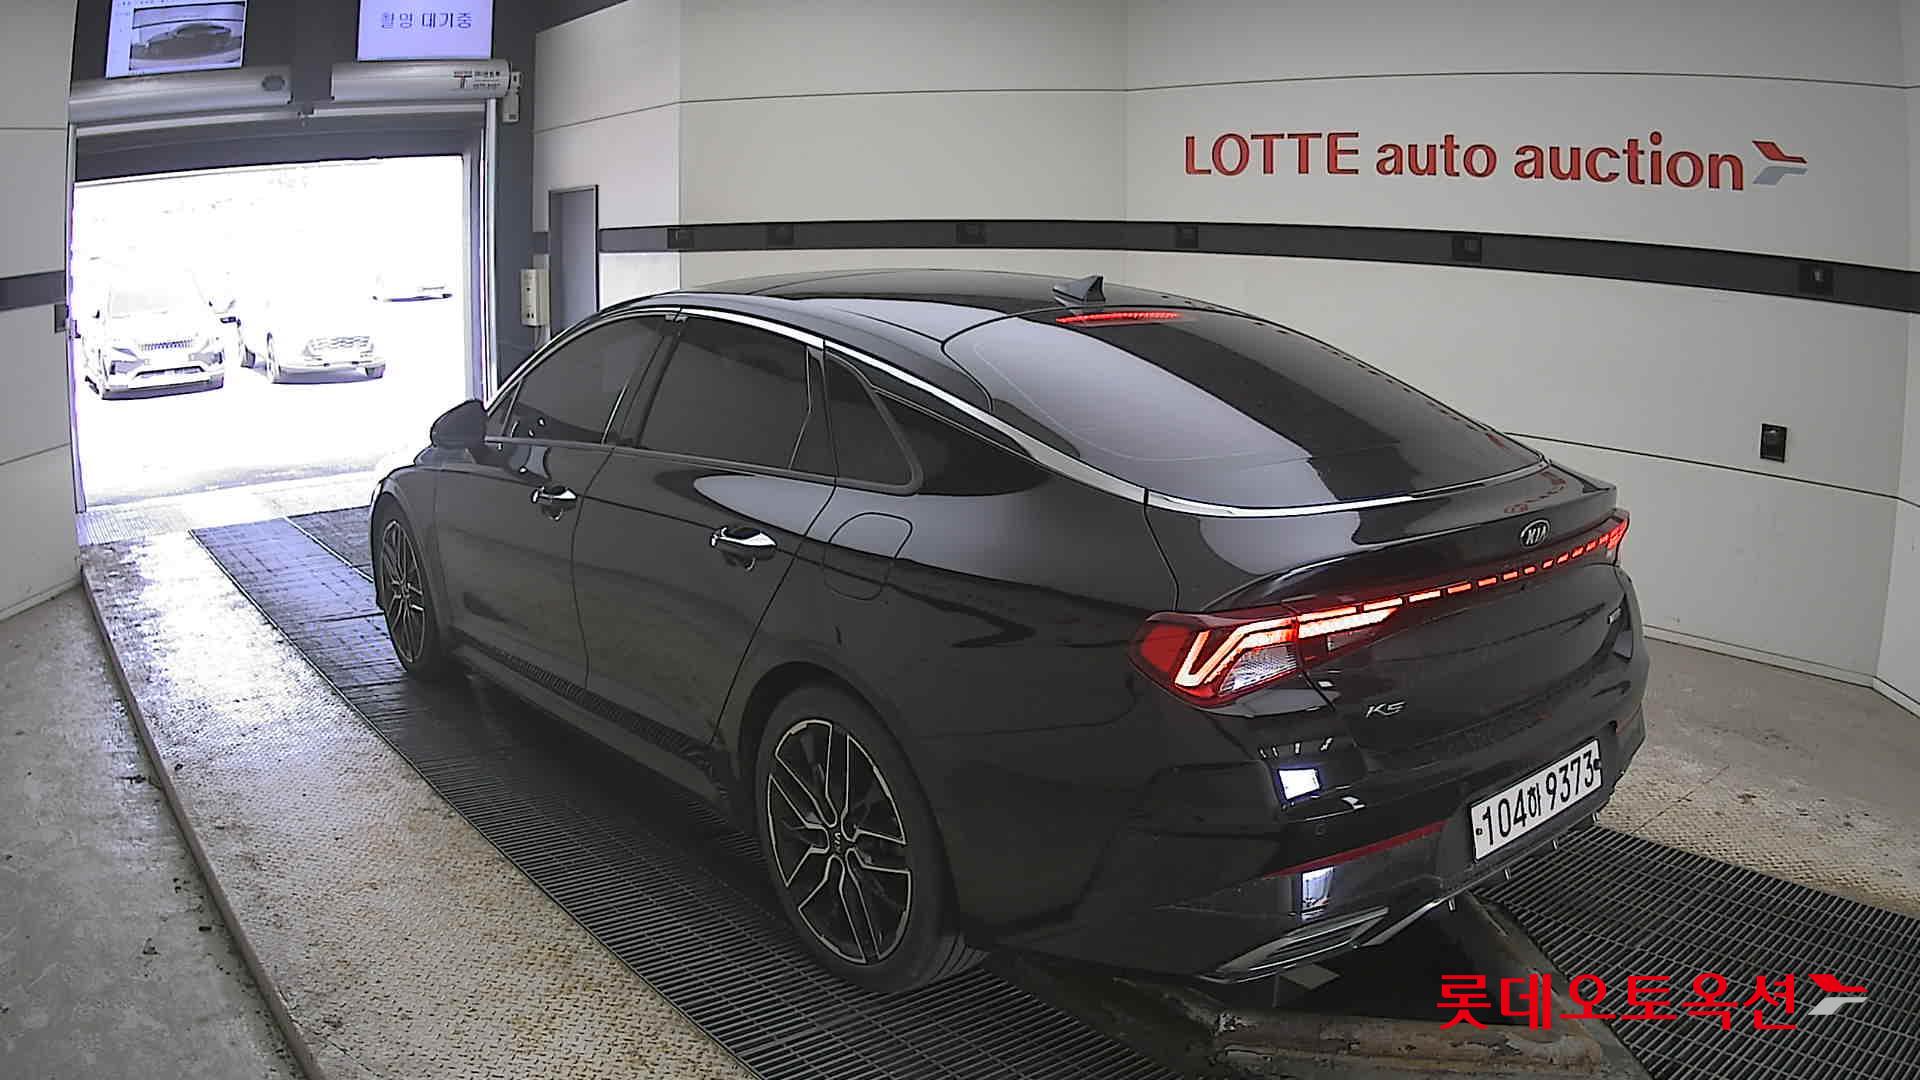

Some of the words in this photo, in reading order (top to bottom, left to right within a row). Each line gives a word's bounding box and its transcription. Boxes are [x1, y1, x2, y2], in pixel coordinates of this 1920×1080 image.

[421, 12, 473, 29] 대기중
[1184, 131, 1360, 176] LOTTE
[1376, 133, 1498, 178] auto
[1513, 131, 1744, 191] auction
[1366, 701, 1406, 718] K5
[1545, 749, 1594, 811] 9373
